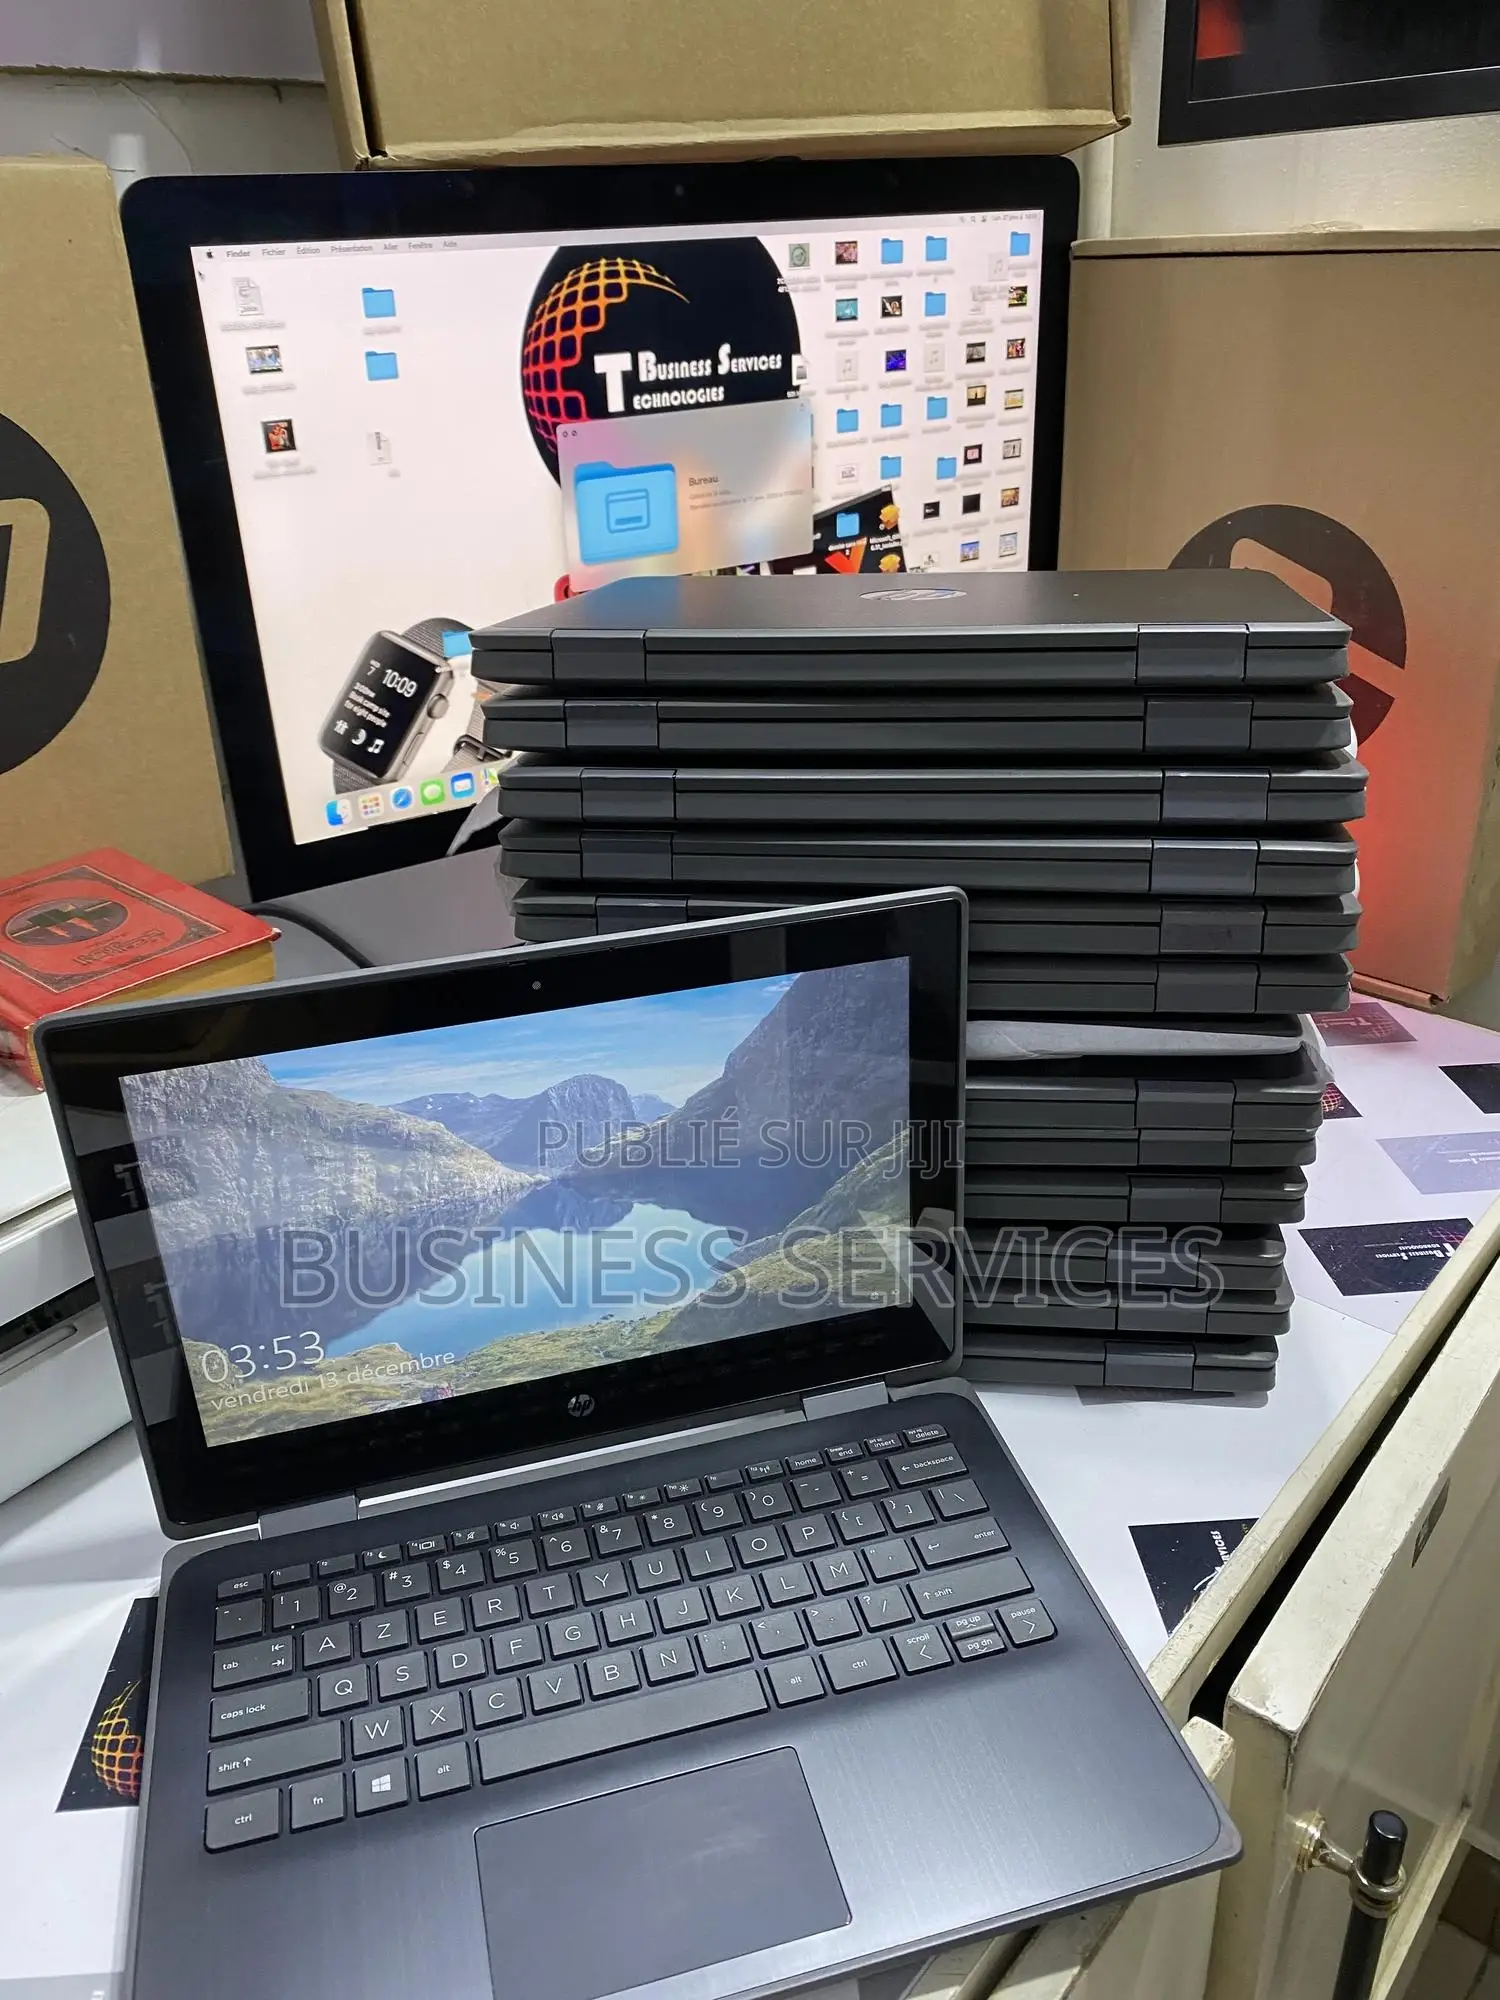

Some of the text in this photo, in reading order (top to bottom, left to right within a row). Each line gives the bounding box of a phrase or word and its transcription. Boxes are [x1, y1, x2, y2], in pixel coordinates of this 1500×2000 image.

[226, 250, 250, 258] Finder
[262, 248, 286, 257] Fichier
[593, 352, 633, 413] T
[688, 476, 719, 487] Bureau
[382, 669, 417, 697] 10:09
[200, 1330, 326, 1385] 03:53
[211, 1350, 455, 1411] vendredi 13 décembre
[567, 1394, 595, 1418] hp
[915, 1429, 939, 1439] delete
[873, 1439, 896, 1448] insert
[838, 1448, 854, 1457] end
[794, 1457, 817, 1467] home
[913, 1455, 954, 1469] backspace
[712, 1506, 724, 1518] 9
[663, 1517, 675, 1529] 8
[612, 1528, 622, 1541] 7
[801, 1526, 815, 1540] P
[974, 1530, 996, 1539] enter
[560, 1541, 572, 1552] 6
[751, 1537, 767, 1551] O
[509, 1552, 520, 1564] 5
[443, 1560, 466, 1575] $ 4
[648, 1561, 664, 1575] U
[829, 1562, 849, 1578] M
[233, 1581, 249, 1589] esc
[389, 1571, 412, 1588] # 3
[595, 1573, 609, 1588] Y
[780, 1576, 795, 1590] L
[334, 1583, 358, 1600] @ 2
[542, 1585, 555, 1600] T
[726, 1587, 744, 1603] K
[934, 1588, 953, 1598] shift
[293, 1600, 300, 1612] 1
[487, 1598, 503, 1614] R
[678, 1600, 688, 1615] J
[1010, 1607, 1036, 1619] pause
[433, 1610, 447, 1626] E
[619, 1612, 636, 1628] H
[955, 1615, 981, 1627] pg up
[377, 1623, 391, 1639] Z
[565, 1625, 582, 1641] G
[318, 1636, 336, 1652] A
[906, 1632, 930, 1645] scroll
[967, 1638, 993, 1651] pg dn
[509, 1639, 523, 1655] F
[452, 1653, 468, 1669] D
[659, 1650, 678, 1666] N
[852, 1659, 868, 1669] ctrl
[222, 1661, 239, 1671] tab
[603, 1664, 620, 1681] B
[396, 1666, 410, 1682] S
[790, 1676, 803, 1685] alt
[334, 1679, 353, 1695] Q
[545, 1678, 562, 1694] V
[488, 1693, 505, 1708] C
[220, 1703, 266, 1720] caps lock
[430, 1706, 447, 1725] X
[364, 1719, 390, 1739] W
[218, 1760, 241, 1773] shift
[437, 1765, 451, 1774] alt
[313, 1796, 324, 1805] fn
[234, 1813, 252, 1824] ctrl
